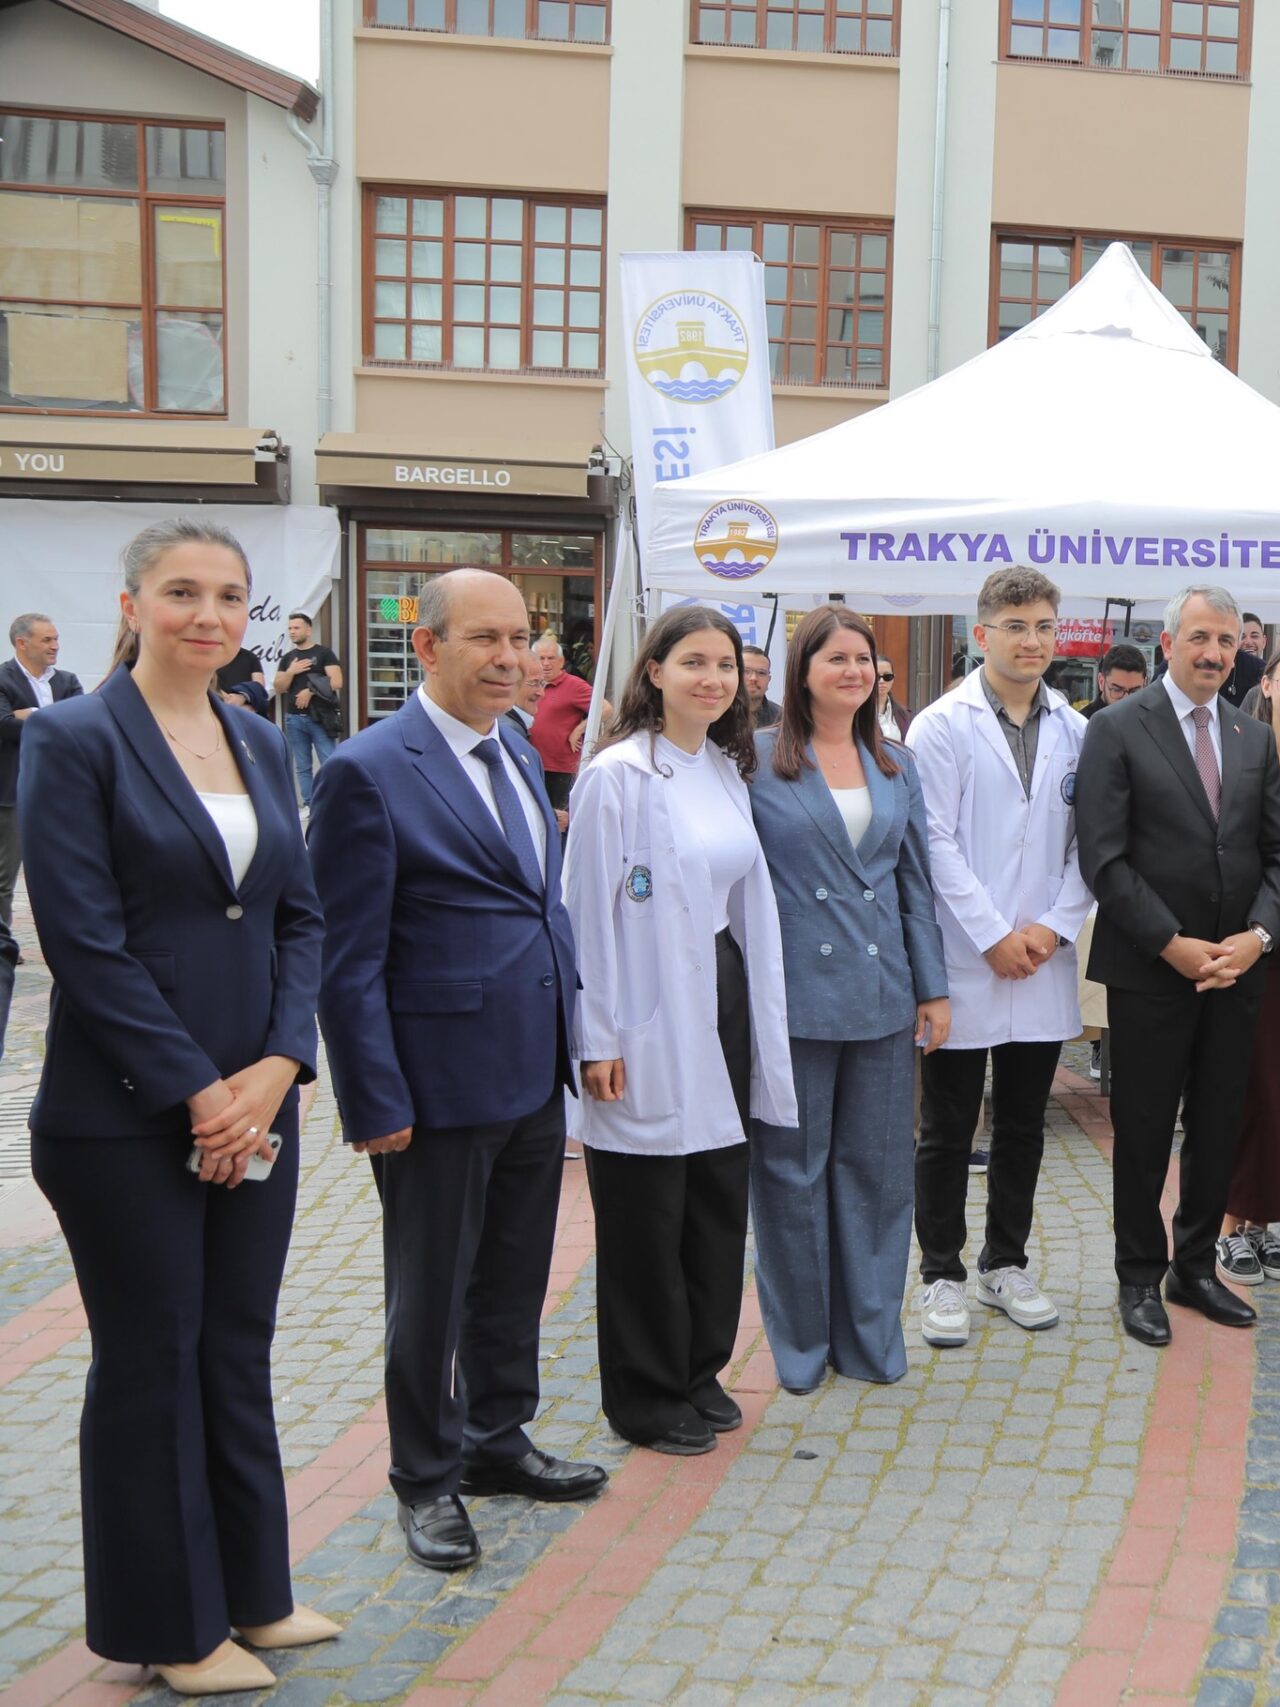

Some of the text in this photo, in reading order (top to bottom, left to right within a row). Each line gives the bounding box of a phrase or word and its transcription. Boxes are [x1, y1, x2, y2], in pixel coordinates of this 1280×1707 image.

[14, 453, 65, 472] YOU
[395, 465, 511, 486] BARGELLO
[699, 501, 776, 539] TRAKYA ÜNİVERSİTESİ
[840, 533, 1013, 562] TRAKYA
